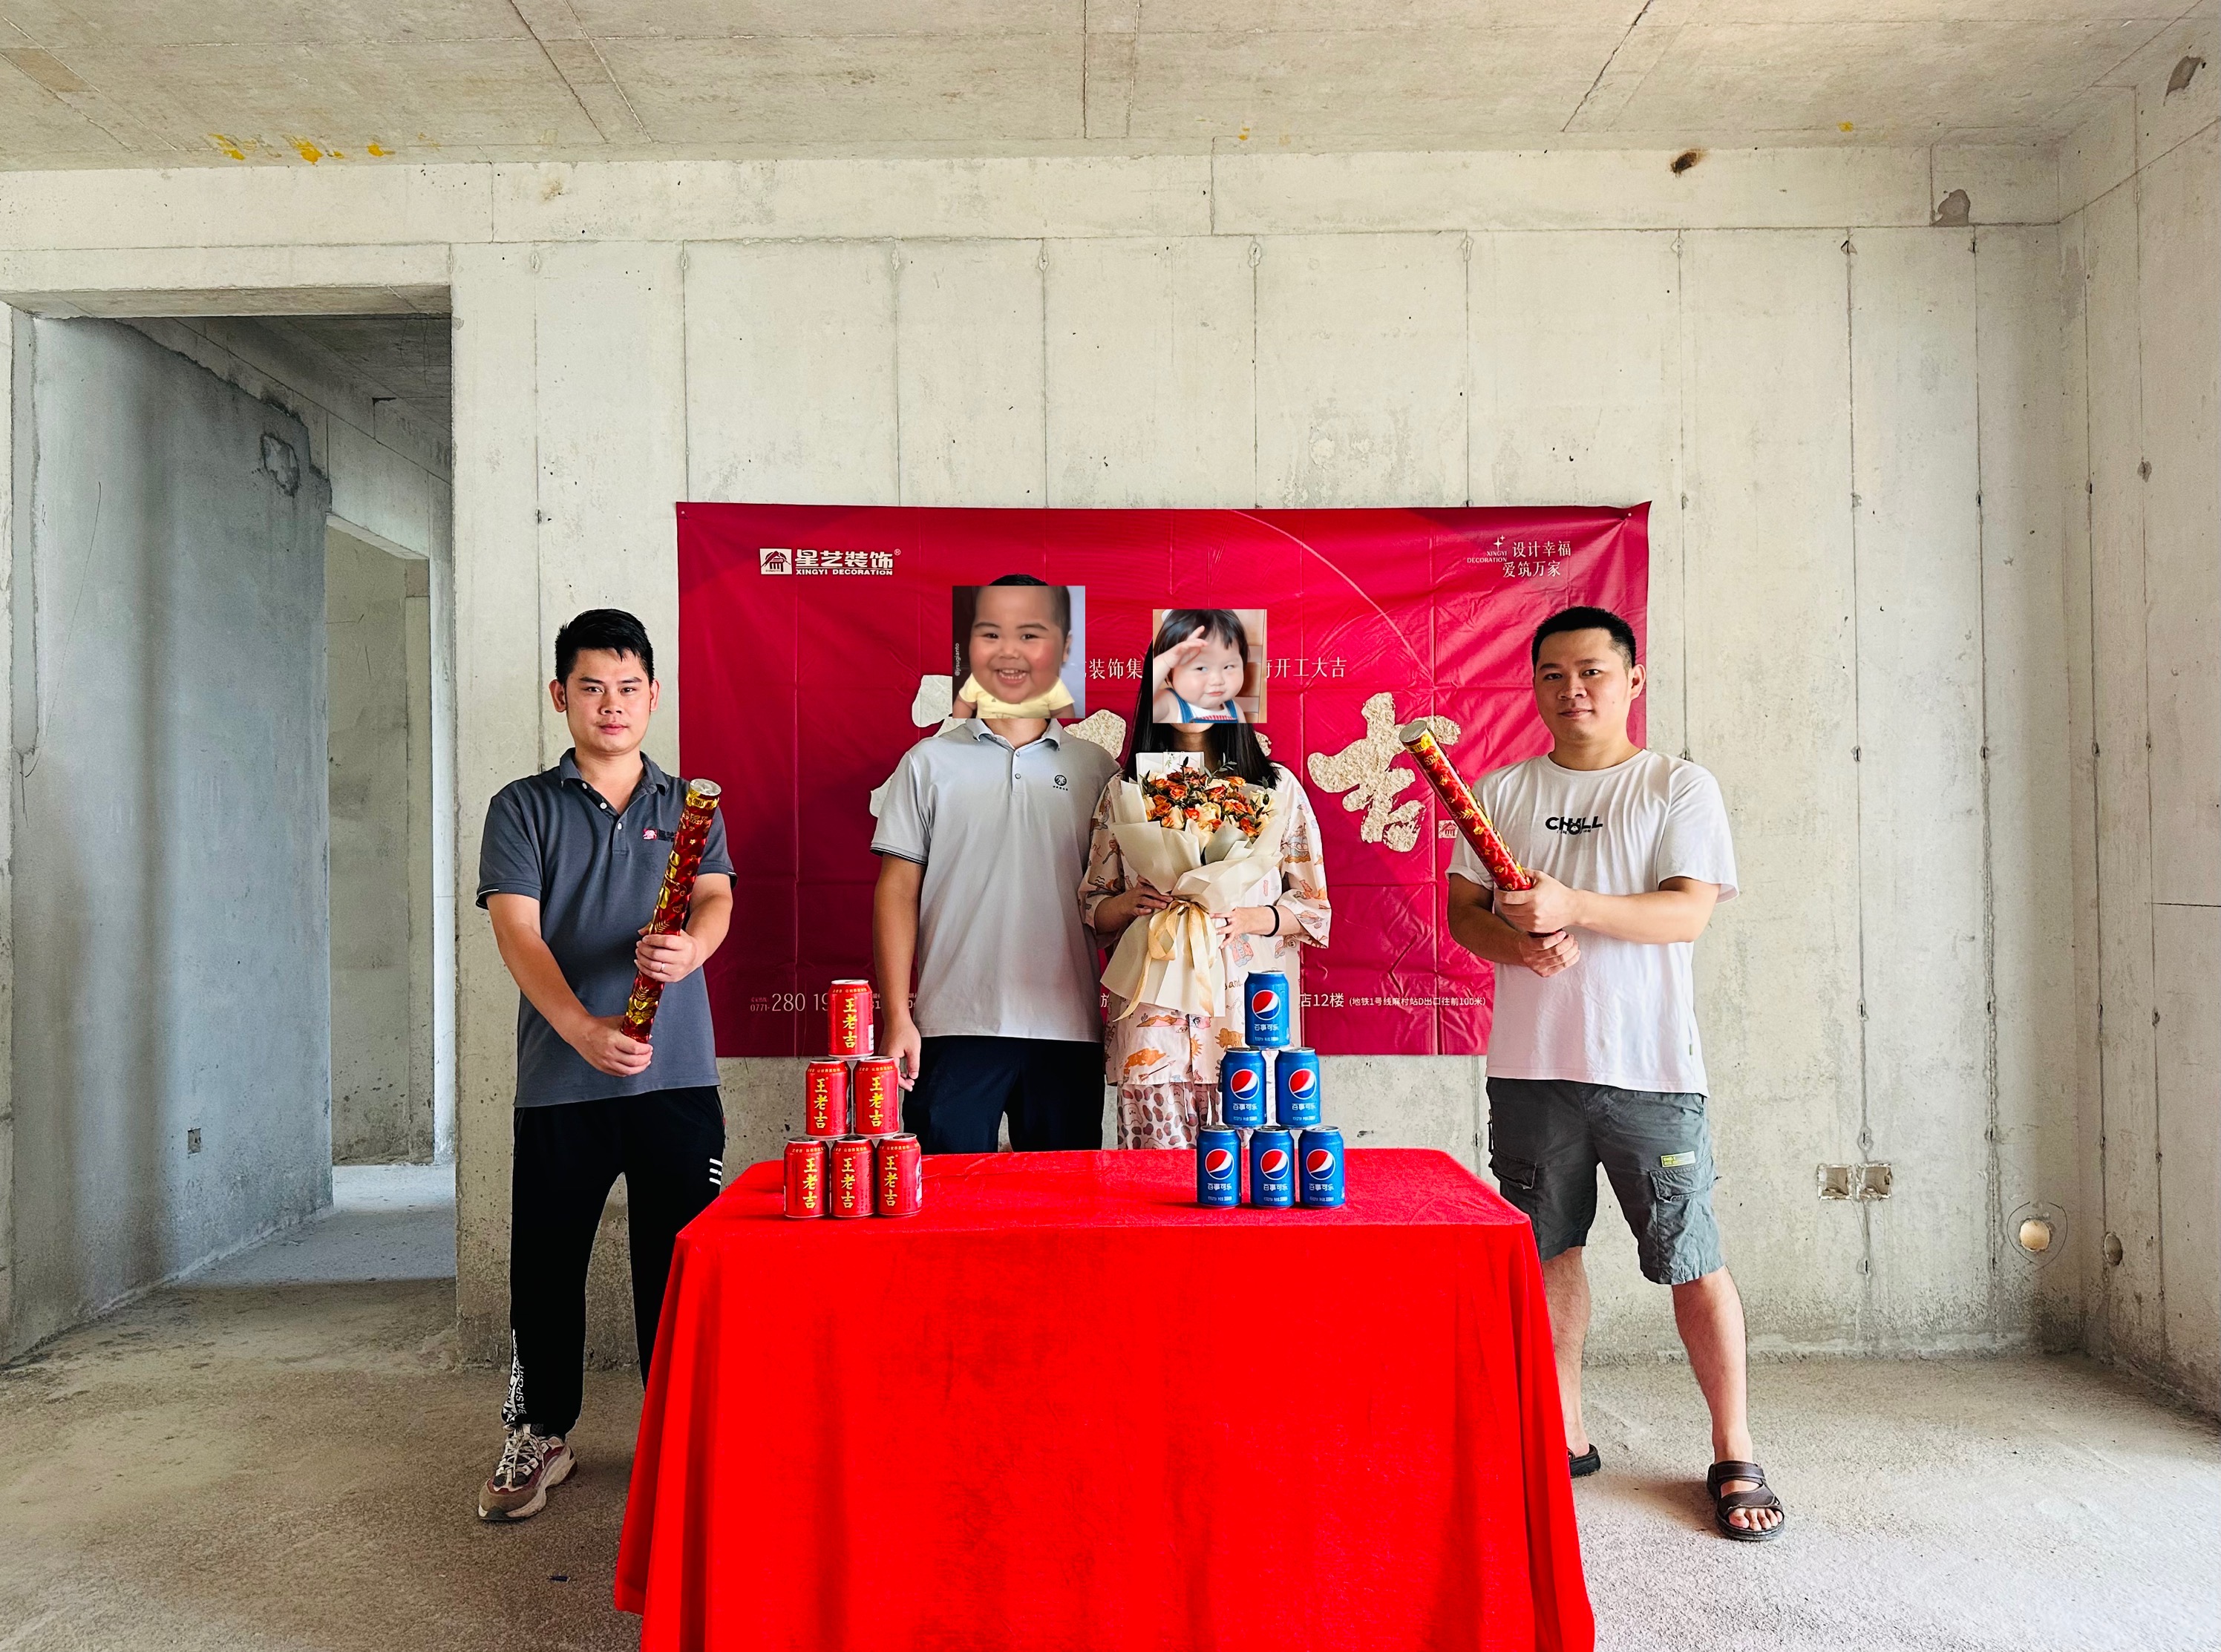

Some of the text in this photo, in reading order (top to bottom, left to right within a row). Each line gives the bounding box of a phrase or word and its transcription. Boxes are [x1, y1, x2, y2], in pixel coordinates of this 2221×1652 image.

[795, 549, 893, 568] 星艺装饰
[1502, 560, 1561, 578] 爱筑万家
[1512, 540, 1571, 557] 设计幸福
[1085, 658, 1143, 680] 装饰集
[843, 998, 857, 1049] 王老吉
[1254, 1023, 1279, 1032] 百事可乐
[814, 1078, 828, 1129] 王老吉
[869, 1076, 884, 1127] 王老吉
[802, 1158, 818, 1209] 王老吉
[841, 1157, 856, 1209] 王老吉
[884, 1156, 898, 1207] 王老吉
